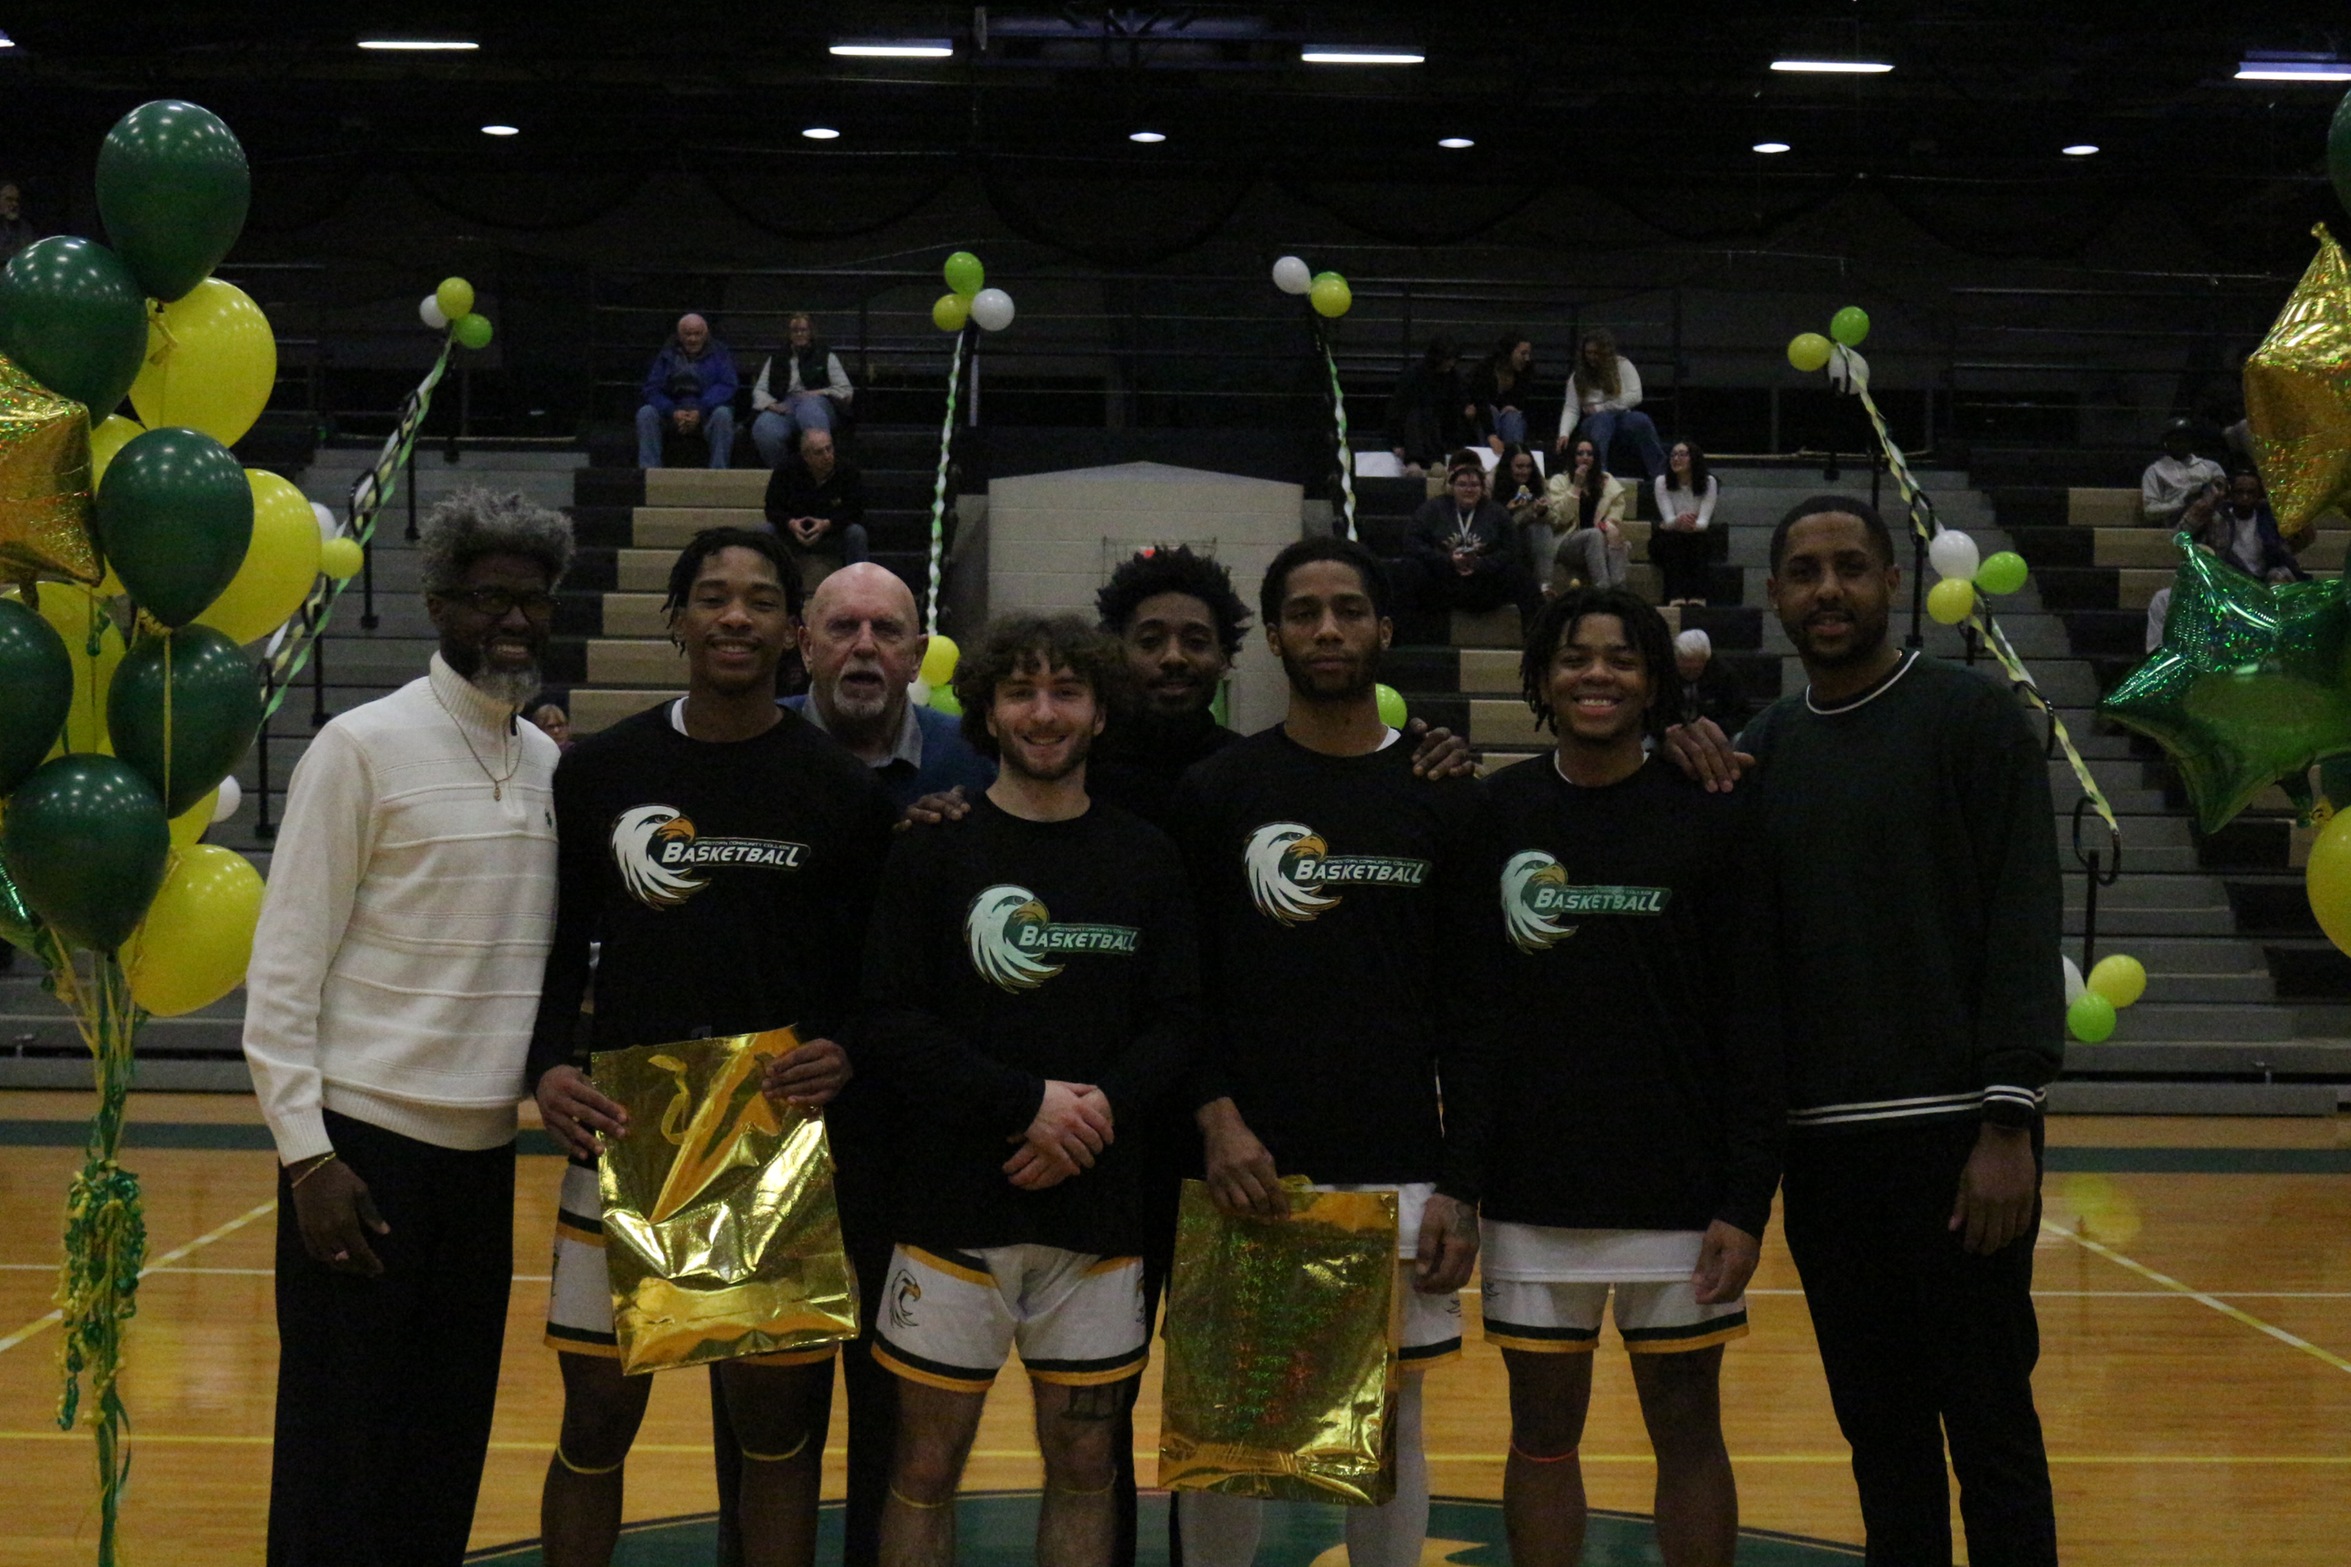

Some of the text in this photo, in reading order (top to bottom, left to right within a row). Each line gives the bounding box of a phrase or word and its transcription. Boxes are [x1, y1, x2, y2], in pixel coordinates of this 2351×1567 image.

[662, 842, 799, 867] BASKETBALL
[1294, 860, 1424, 883] BASKETBALL
[1534, 888, 1661, 911] BASKETBALL
[1019, 925, 1137, 951] BASKETBALL
